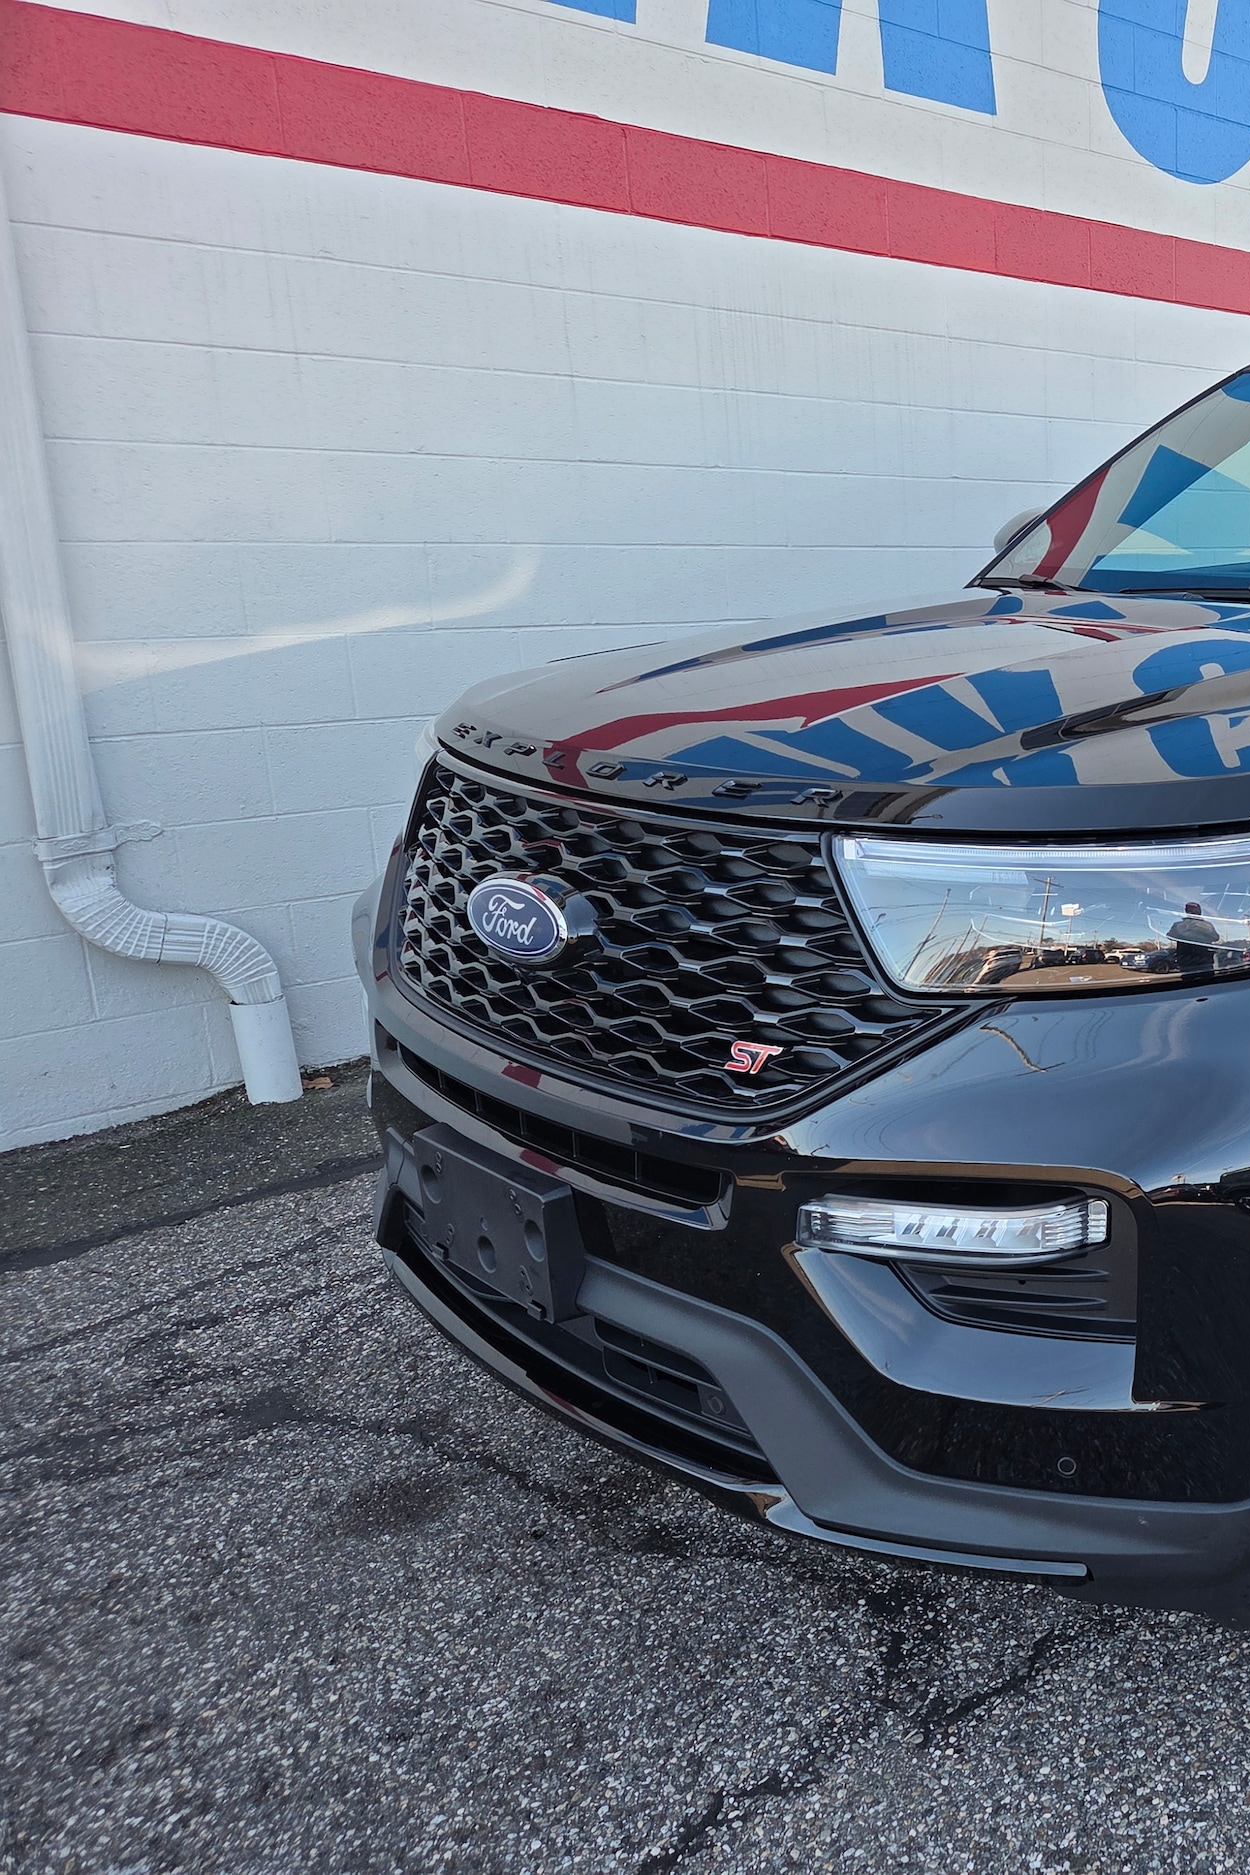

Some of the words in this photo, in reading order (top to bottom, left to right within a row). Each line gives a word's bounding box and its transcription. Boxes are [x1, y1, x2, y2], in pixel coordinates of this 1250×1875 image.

[451, 721, 843, 807] EXPLORER
[482, 894, 537, 945] Ford
[724, 1041, 784, 1074] ST
